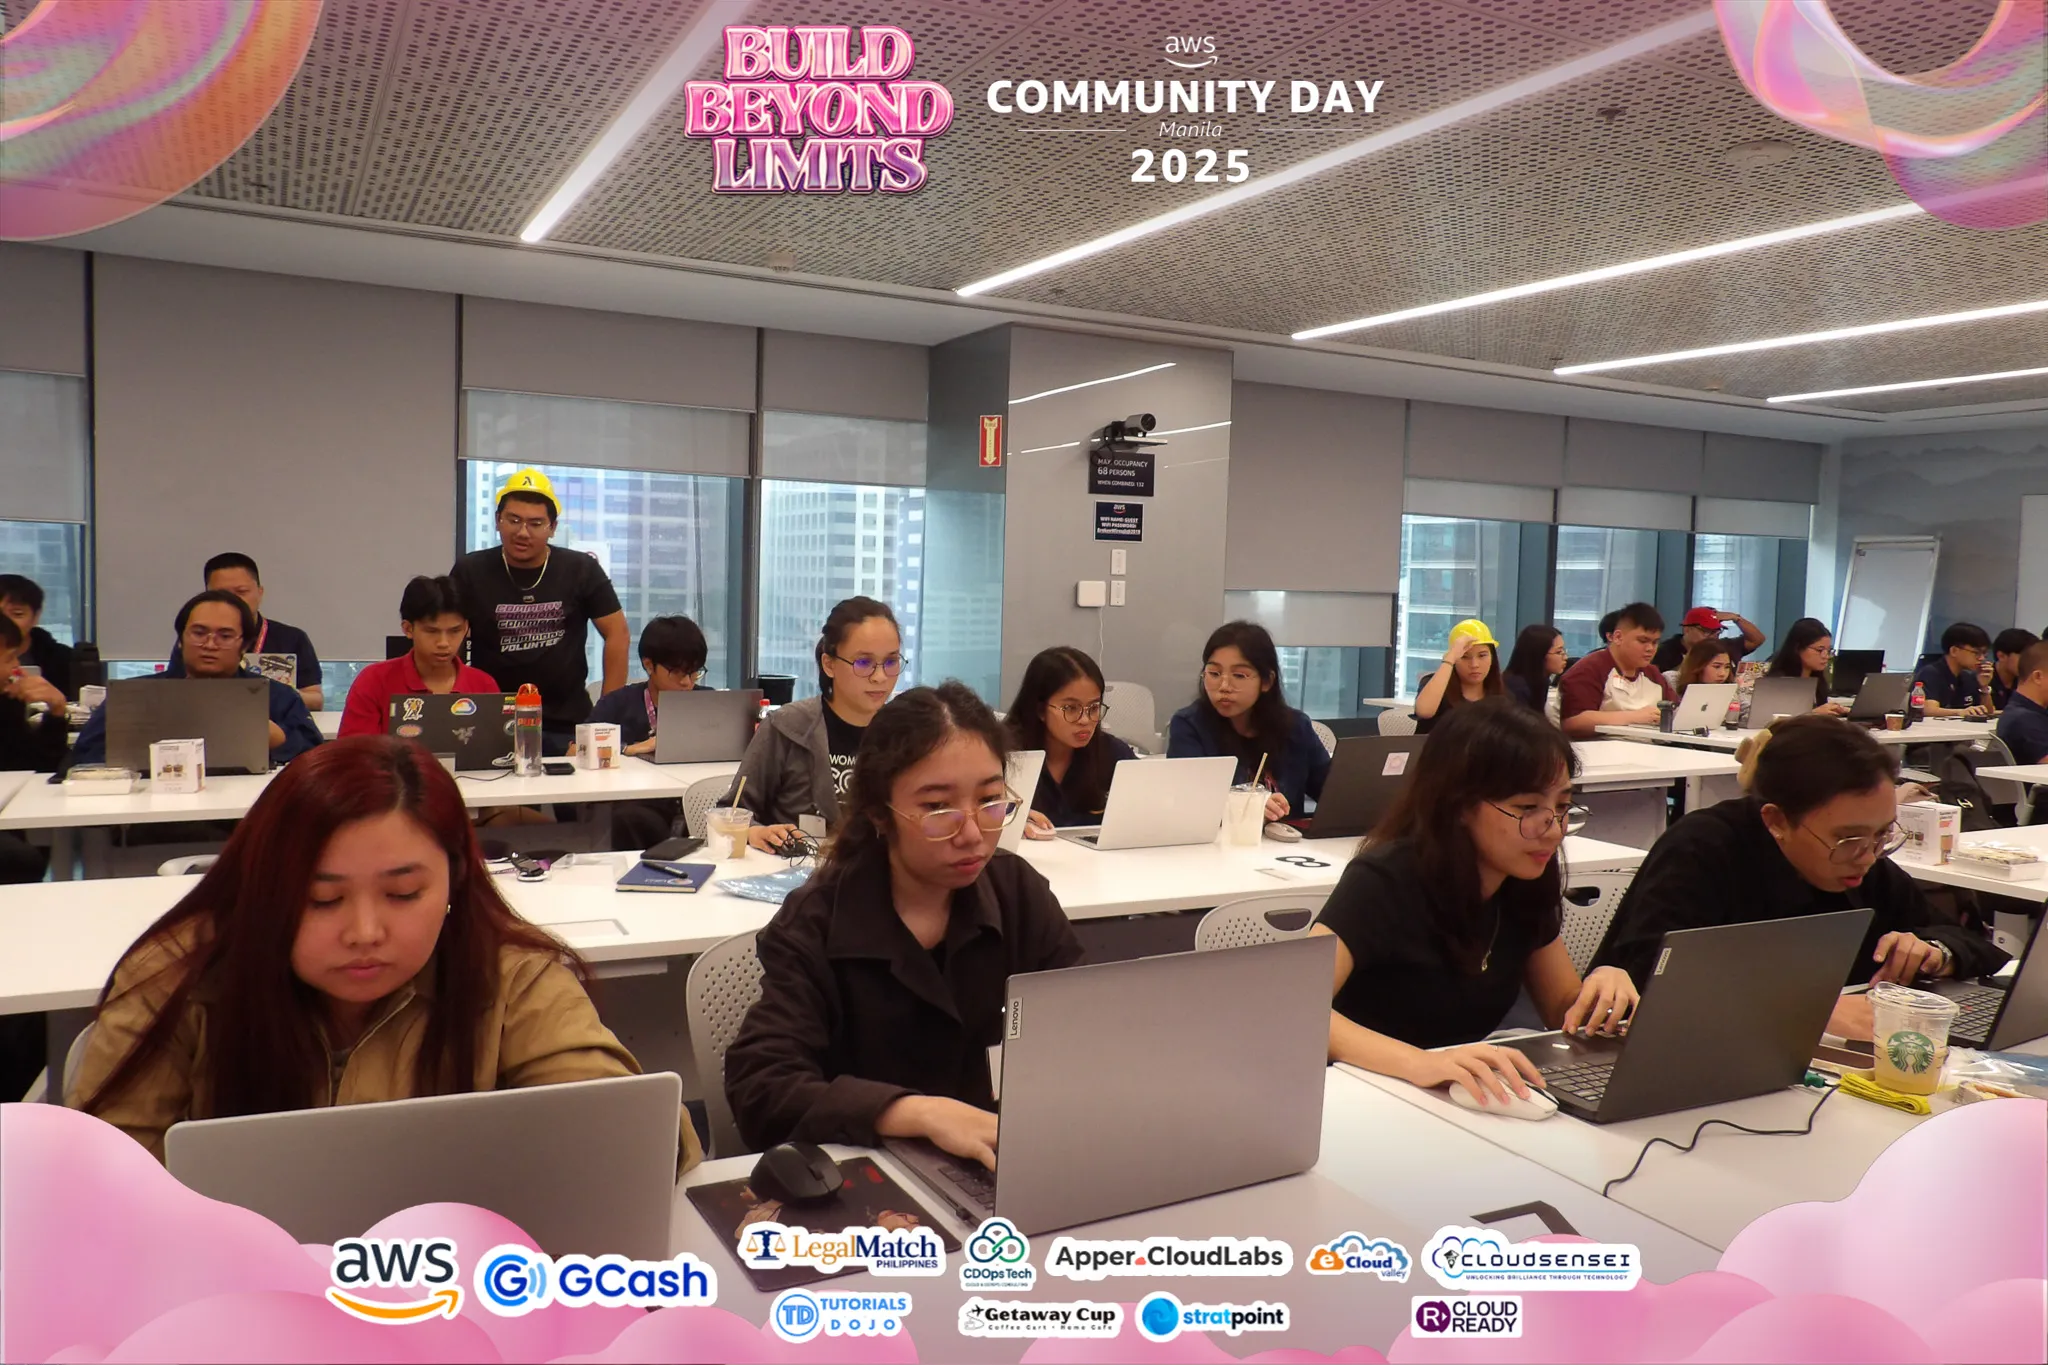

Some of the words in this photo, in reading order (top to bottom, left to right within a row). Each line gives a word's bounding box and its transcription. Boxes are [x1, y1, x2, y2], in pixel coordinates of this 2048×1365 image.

[1113, 460, 1149, 468] OCCUPANCY
[1097, 466, 1108, 475] 68
[1109, 469, 1136, 477] PERSONS
[829, 753, 859, 766] WOM
[1010, 1001, 1020, 1036] Lenovo
